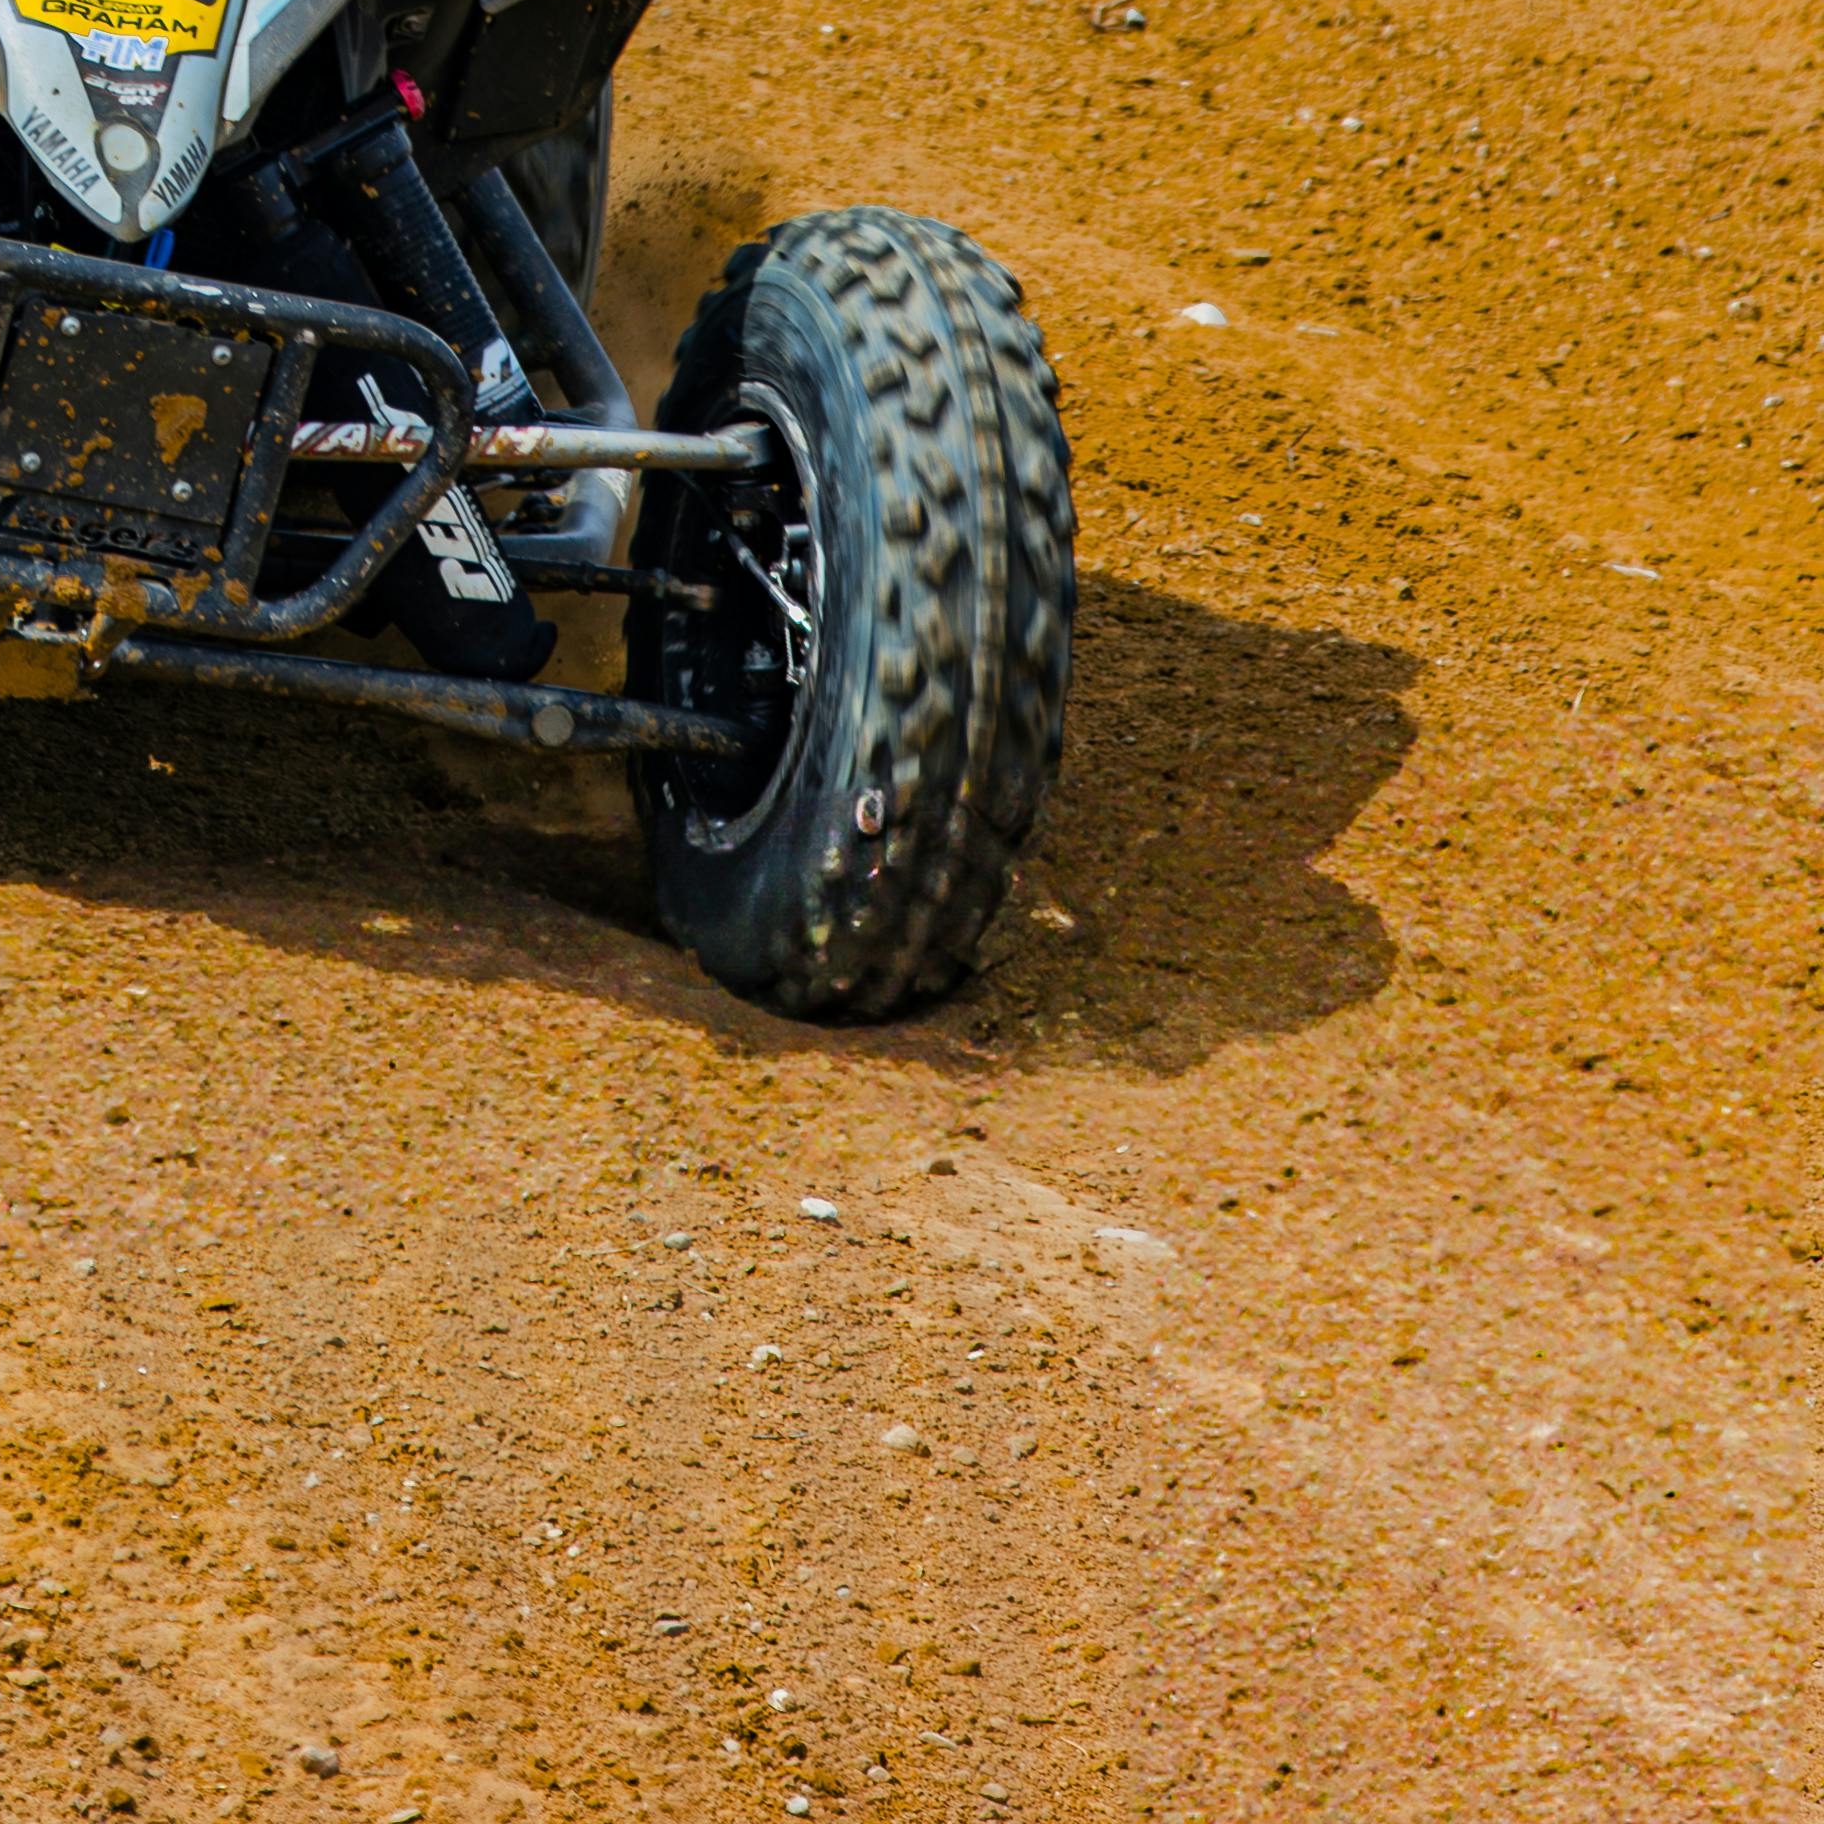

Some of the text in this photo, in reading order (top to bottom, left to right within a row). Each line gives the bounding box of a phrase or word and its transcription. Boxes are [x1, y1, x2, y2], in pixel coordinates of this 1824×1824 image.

[84, 30, 168, 71] FIM
[22, 105, 102, 195] YAMAHA
[153, 133, 209, 210] YAMAHA
